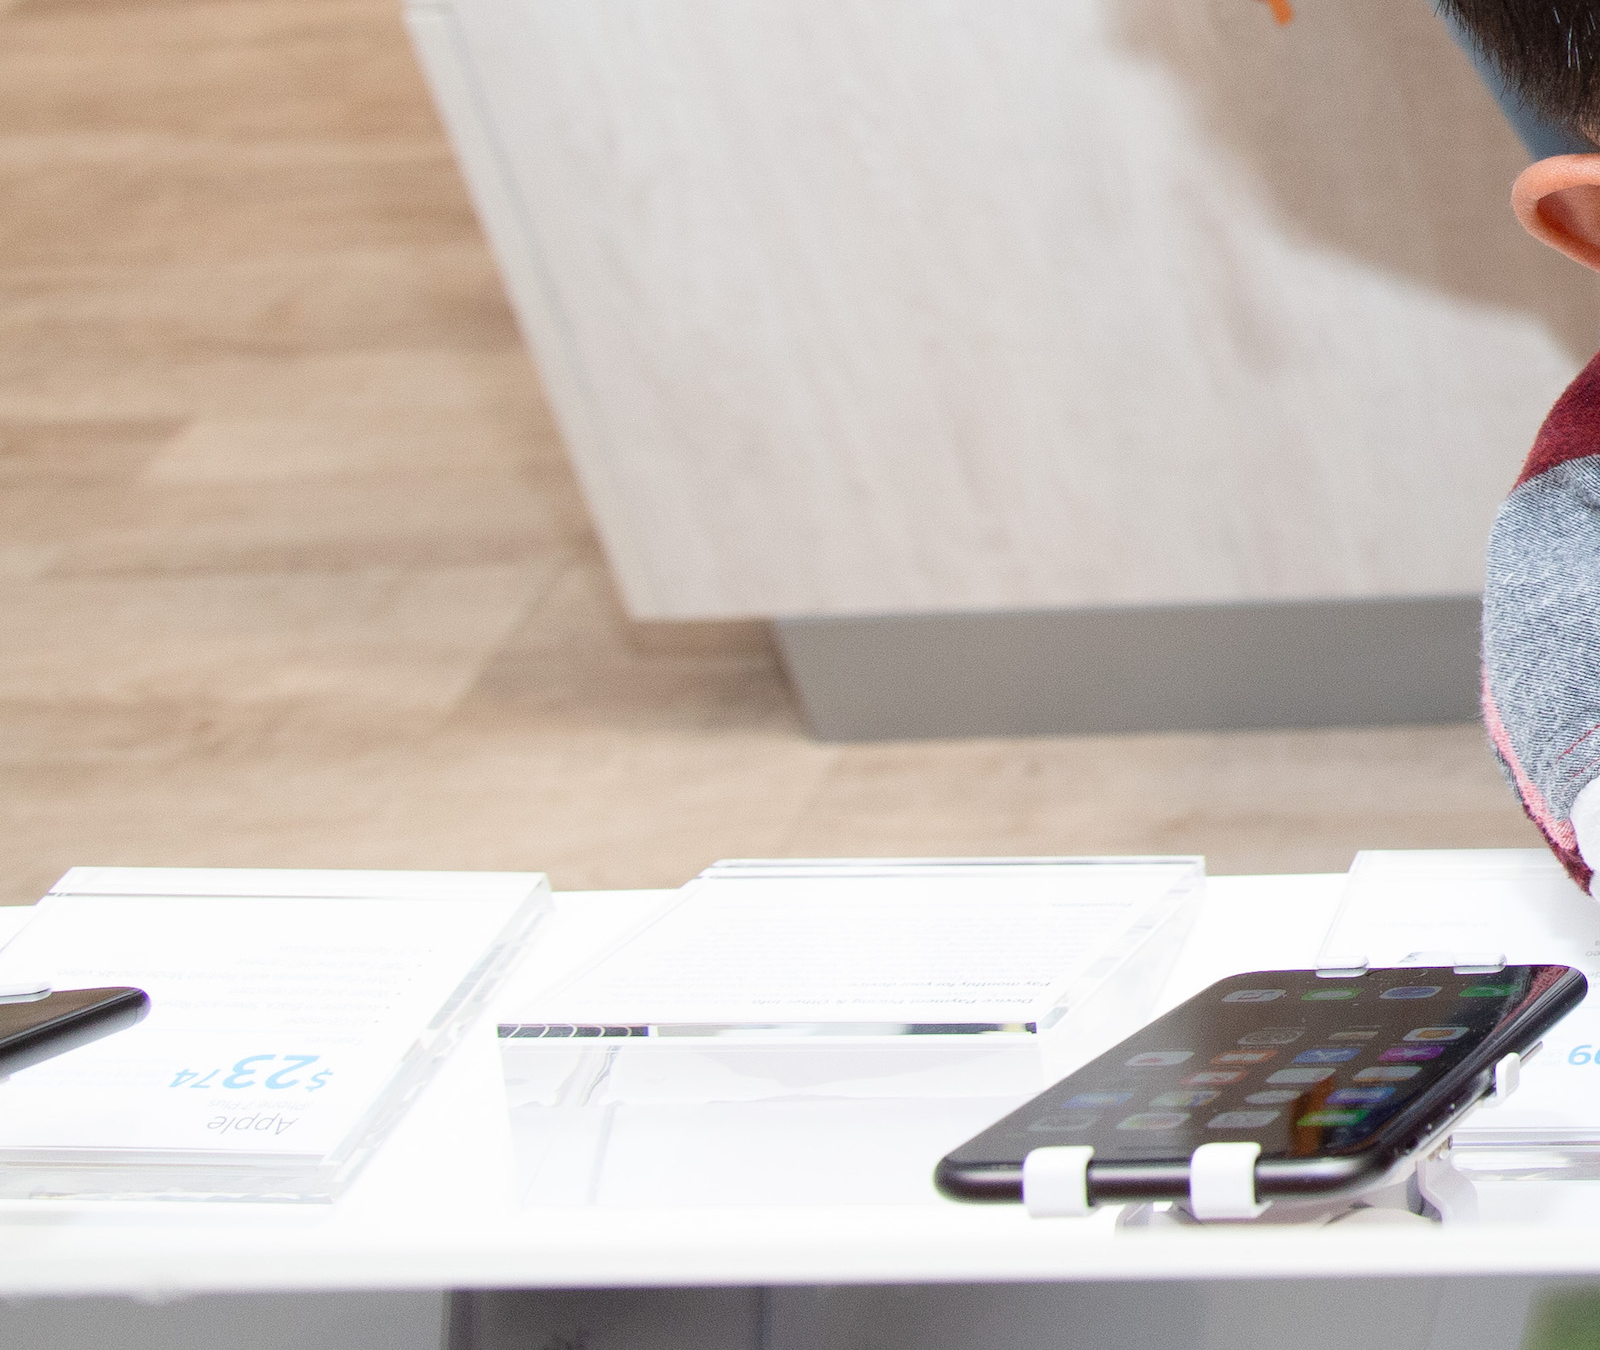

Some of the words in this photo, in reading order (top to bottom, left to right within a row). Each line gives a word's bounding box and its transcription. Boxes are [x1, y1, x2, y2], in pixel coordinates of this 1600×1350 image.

[207, 1099, 241, 1111] Plus
[241, 1100, 256, 1110] 7
[259, 1100, 312, 1110] iPhone
[206, 1112, 300, 1136] Apple
